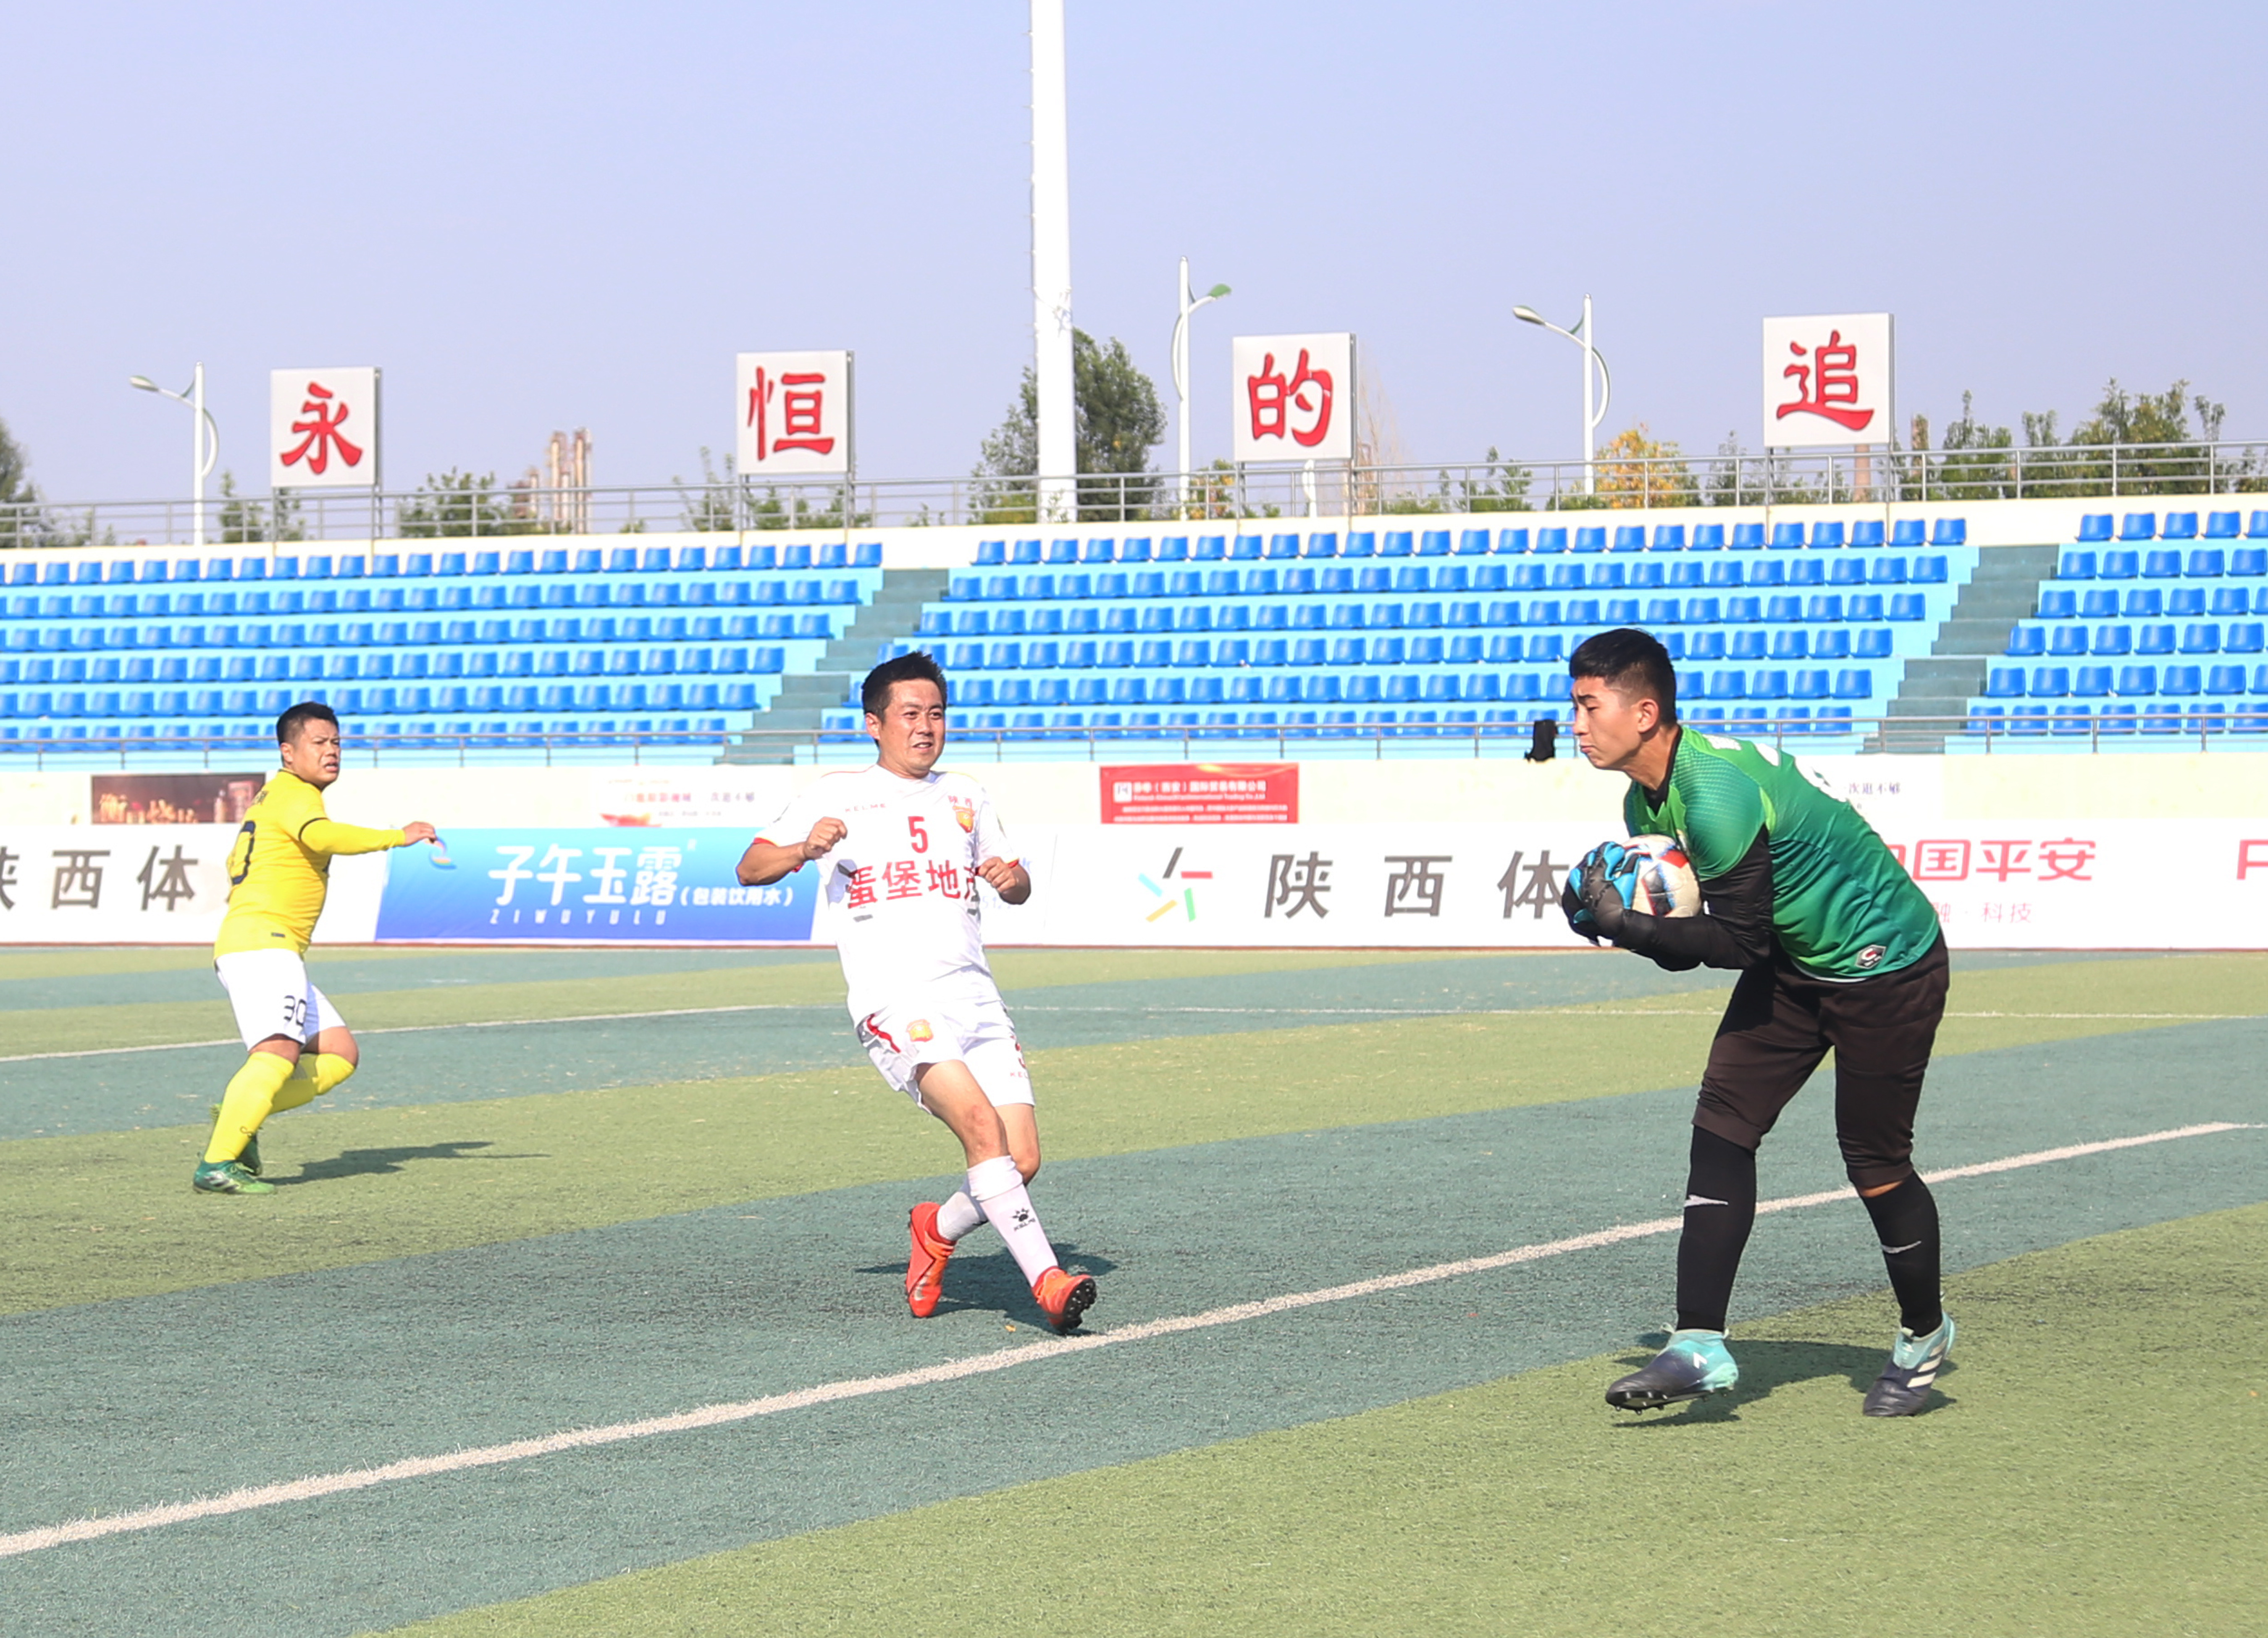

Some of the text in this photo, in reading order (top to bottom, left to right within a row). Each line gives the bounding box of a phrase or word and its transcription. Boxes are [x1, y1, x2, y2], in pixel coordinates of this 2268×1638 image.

[280, 329, 1874, 475] 永 恒 的 追
[908, 816, 929, 853] 5
[488, 843, 682, 906] 子午玉露
[1264, 850, 1570, 920] 陕西体
